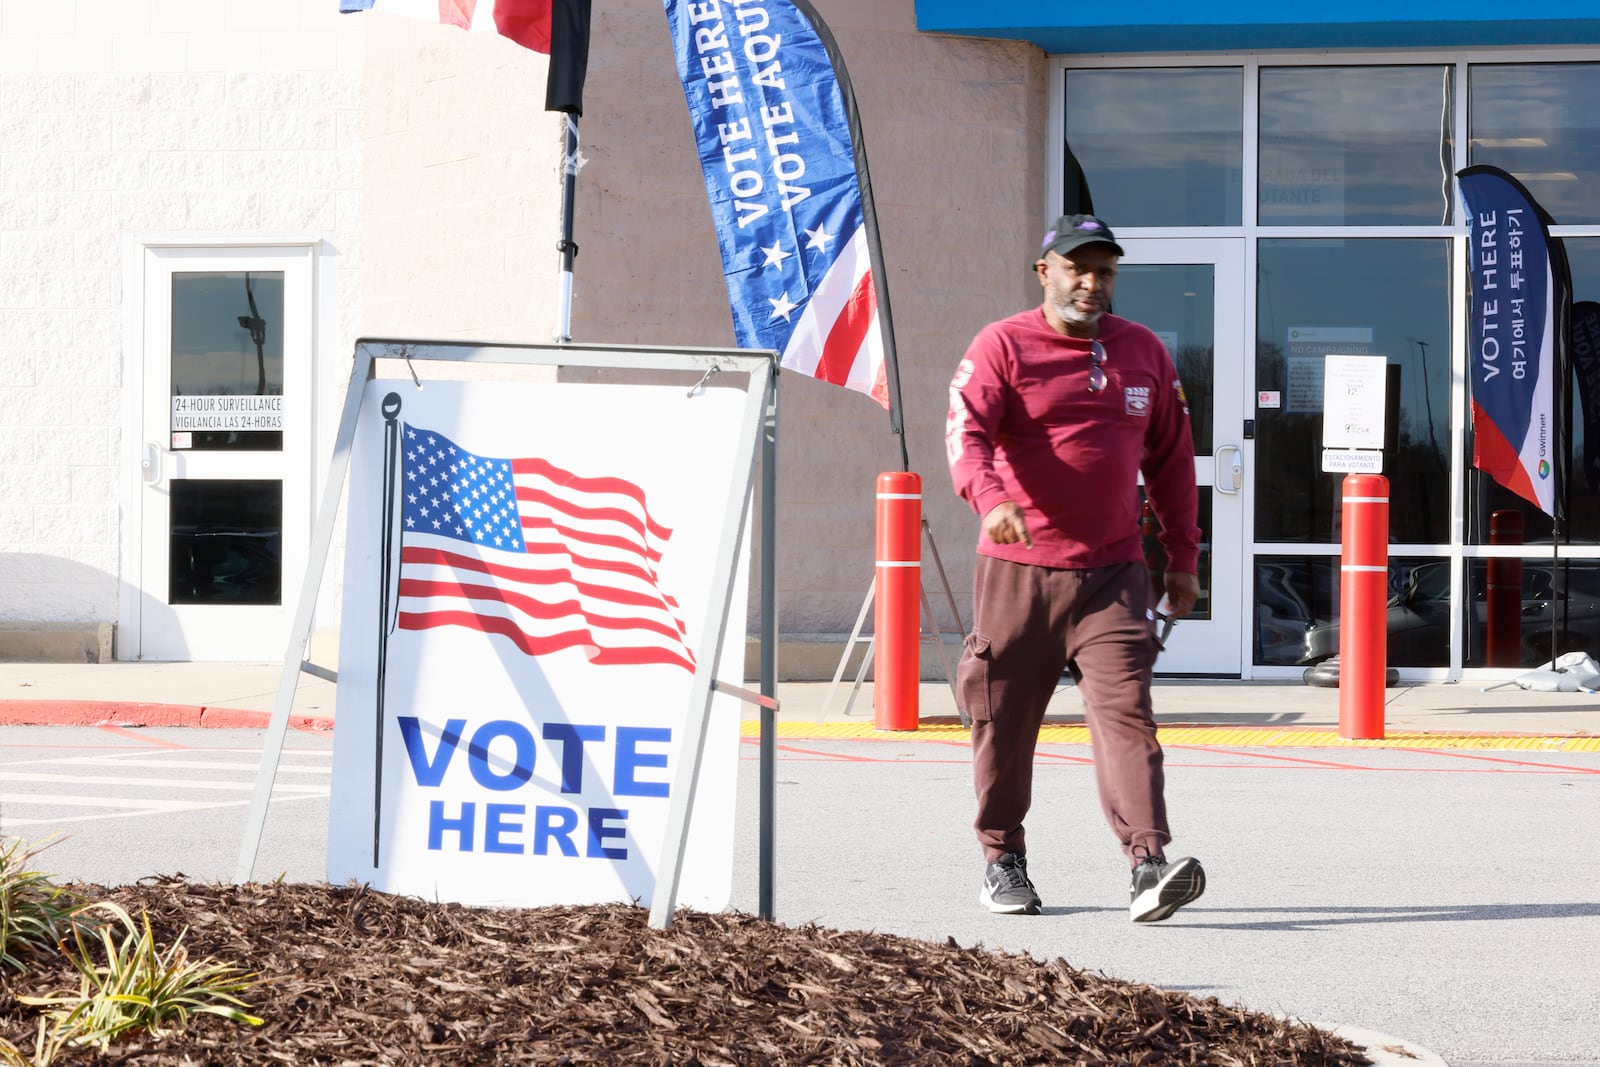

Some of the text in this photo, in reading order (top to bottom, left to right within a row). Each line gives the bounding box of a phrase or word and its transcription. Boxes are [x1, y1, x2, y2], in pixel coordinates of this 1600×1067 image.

[687, 0, 769, 229] VOTE HERE
[732, 0, 812, 212] VOTE AQU
[1480, 210, 1500, 383] VOTE HERE
[1506, 209, 1527, 379] 여기에서 투표하기
[175, 398, 281, 411] 24-HOUR SURVEILLANCE
[175, 416, 282, 428] VIGILANCIA LAS 24-HORAS
[1538, 413, 1546, 457] Gwinnett
[1325, 453, 1381, 462] ESTACIONAMIENTO
[397, 716, 672, 798] VOTE
[427, 800, 629, 860] HERE
